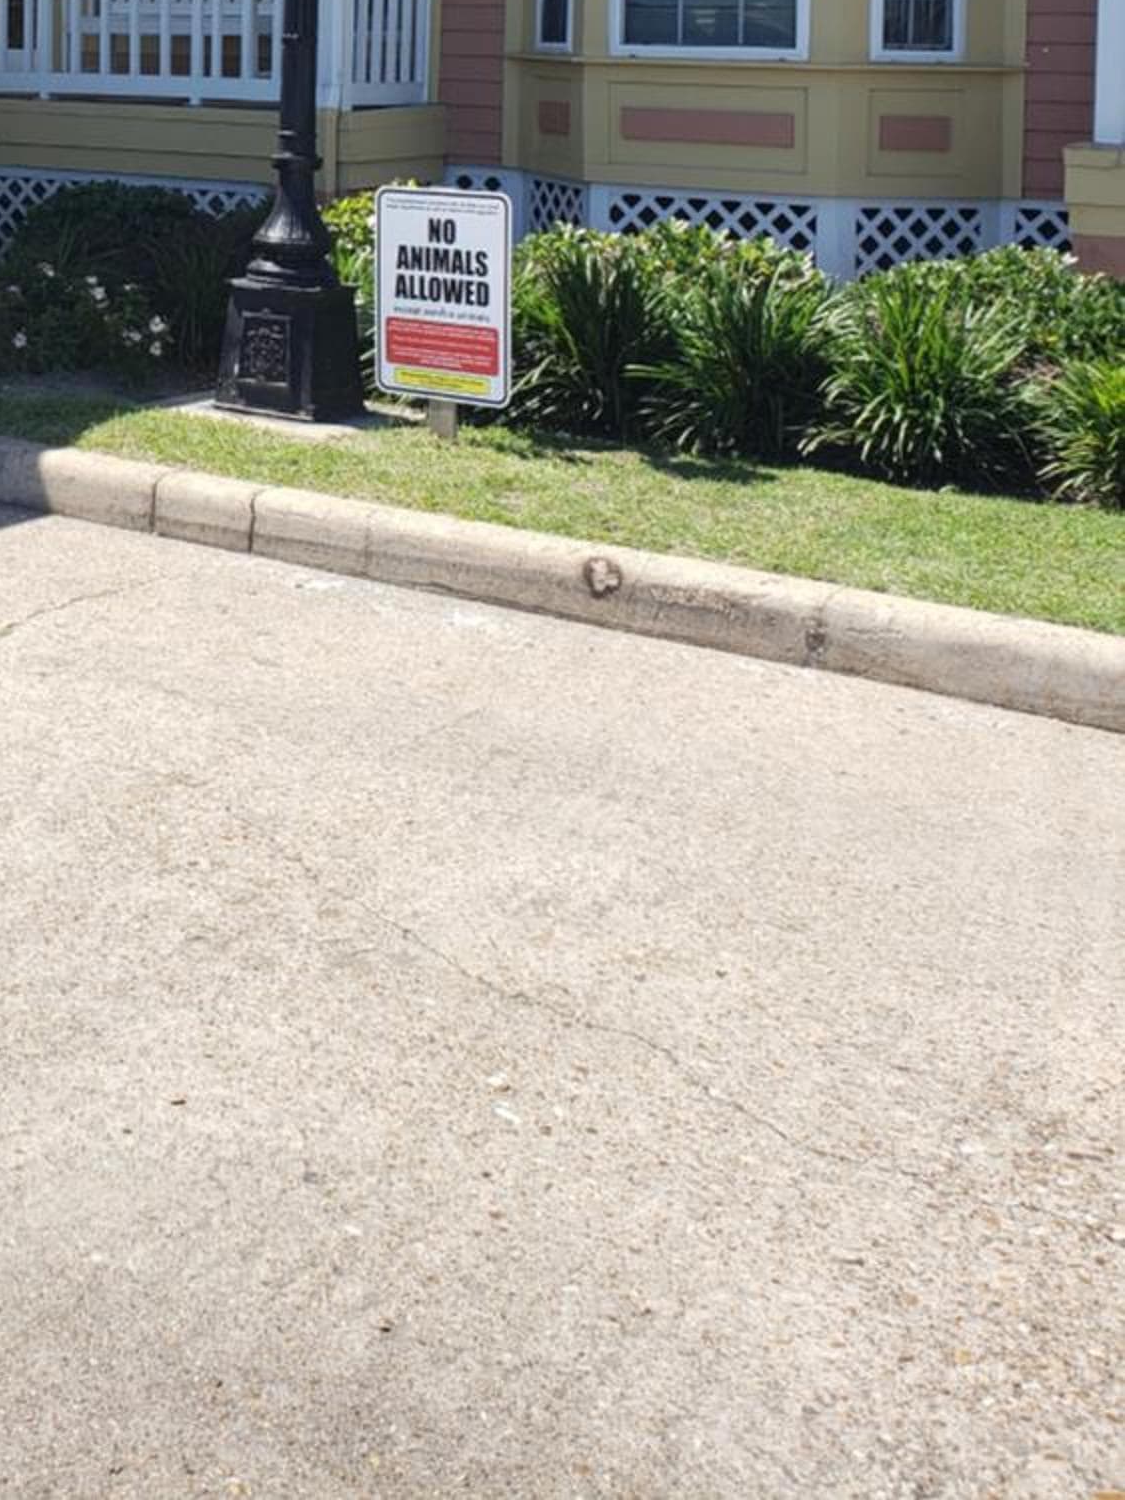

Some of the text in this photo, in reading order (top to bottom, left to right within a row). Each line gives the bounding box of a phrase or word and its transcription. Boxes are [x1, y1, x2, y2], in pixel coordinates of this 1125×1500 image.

[428, 218, 457, 244] NO
[396, 245, 489, 277] ANIMALS
[395, 273, 490, 307] ALLOWED
